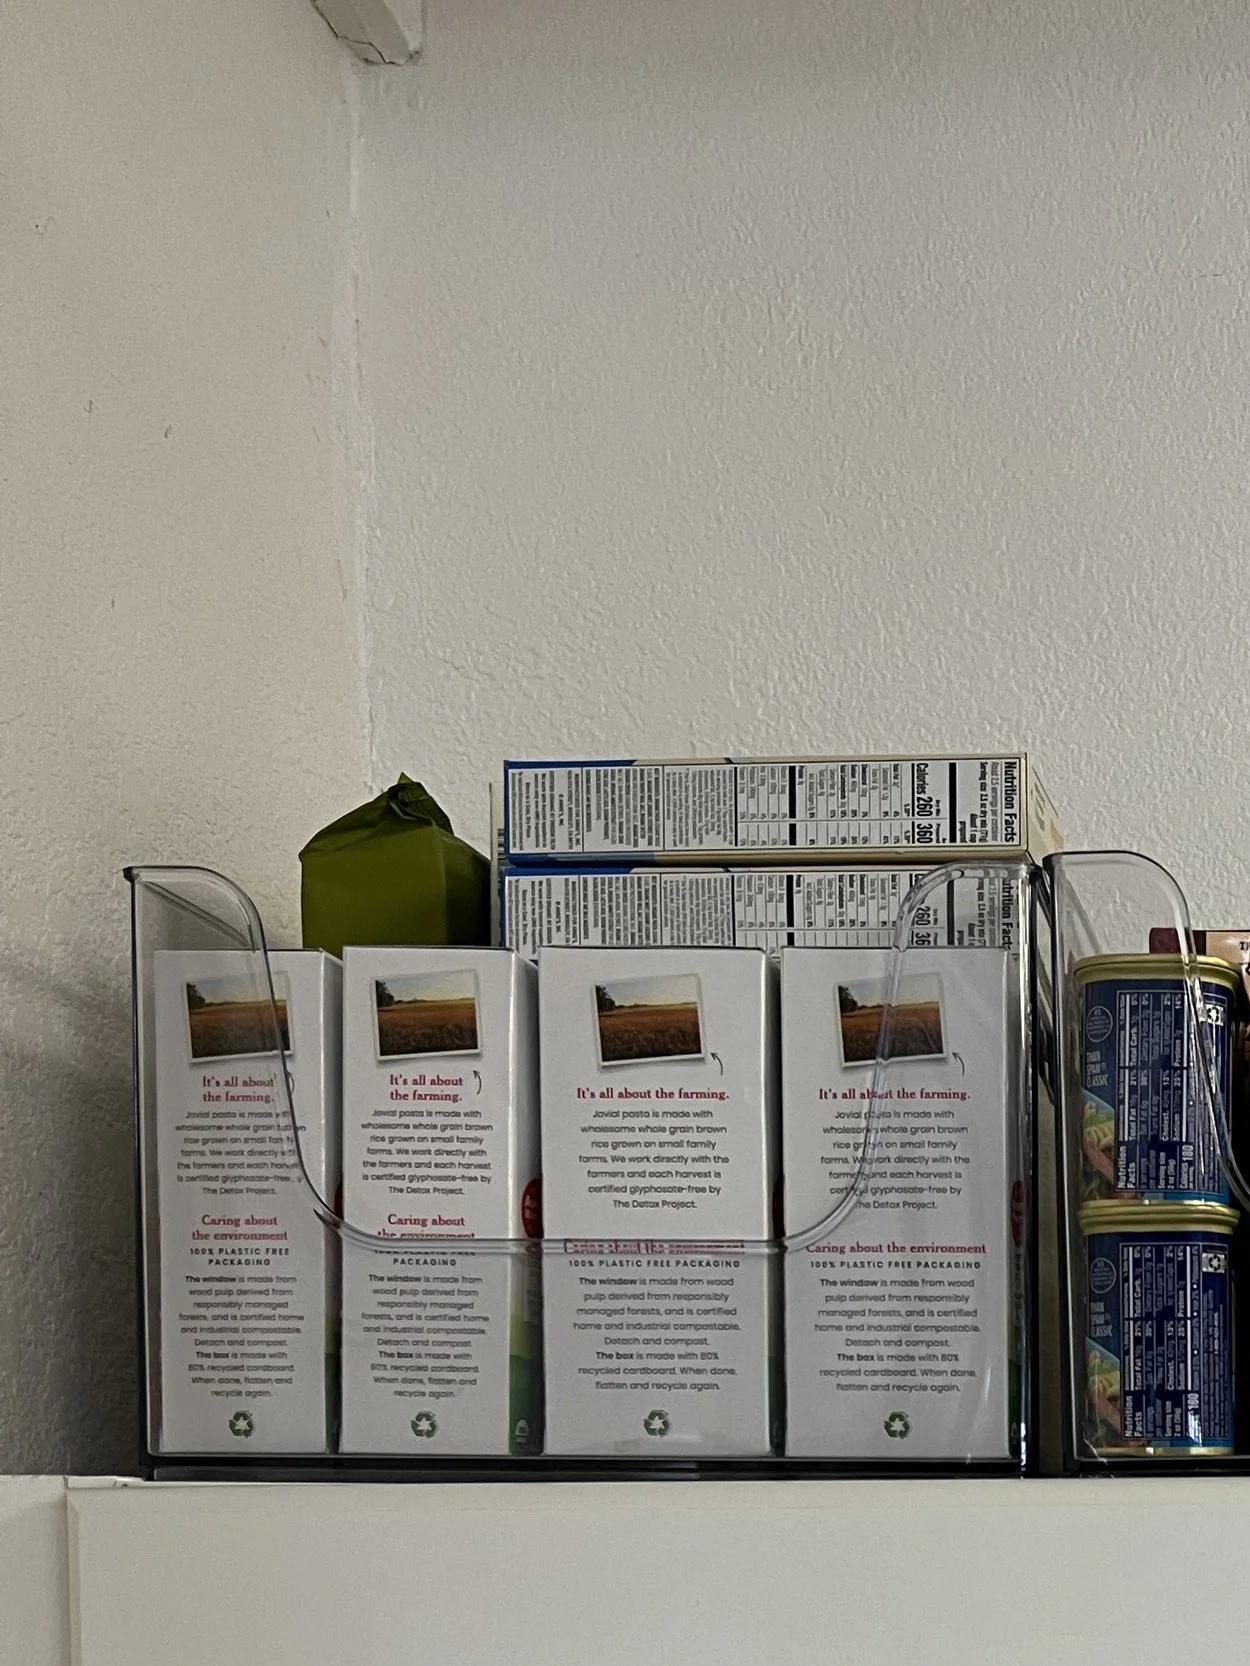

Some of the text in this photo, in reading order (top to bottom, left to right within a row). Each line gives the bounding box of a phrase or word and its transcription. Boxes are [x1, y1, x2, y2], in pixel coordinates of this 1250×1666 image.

[916, 763, 933, 843] Calories 260 360
[1004, 761, 1017, 843] Nutrition Facts
[1002, 880, 1014, 919] utrition
[915, 906, 931, 926] 260
[203, 1076, 275, 1087] It's all about
[390, 1074, 463, 1086] It's all about
[203, 1091, 274, 1104] the farming.
[390, 1089, 462, 1103] the farming.
[577, 1087, 729, 1101] It's all about the farming.
[819, 1088, 838, 1100] It's
[841, 1088, 856, 1099] all
[897, 1087, 916, 1099] the
[920, 1088, 970, 1101] farming.
[593, 1109, 713, 1120] Jovial pasta is made with
[580, 1125, 727, 1135] wholesome whole grain brown
[591, 1140, 609, 1148] rice
[611, 1141, 642, 1151] grown
[658, 1140, 684, 1148] small
[686, 1140, 717, 1151] family
[1182, 1145, 1194, 1161] 180
[579, 1155, 730, 1165] farms. We work directly with the
[1118, 1145, 1126, 1189] Nutrition
[587, 1170, 722, 1179] farmers and each harvest is
[1127, 1162, 1135, 1189] Facts
[588, 1184, 721, 1196] certified glyphosate-free by
[613, 1199, 697, 1210] The Detox Project.
[201, 1214, 278, 1228] Caring about
[387, 1213, 465, 1228] Caring about
[192, 1229, 288, 1240] the environment
[190, 1248, 214, 1256] 100%
[265, 1248, 289, 1256] FREE
[806, 1241, 986, 1255] Caring about the environment
[208, 1258, 270, 1266] PACKAGING
[393, 1258, 456, 1266] PACKAGING
[676, 1260, 740, 1268] PACKAGING
[840, 1261, 883, 1269] PLASTIC
[888, 1261, 912, 1269] FREE
[916, 1261, 981, 1269] PACKAGING
[579, 1277, 597, 1285] The
[598, 1277, 638, 1285] window
[680, 1277, 704, 1285] from
[706, 1278, 734, 1286] wood
[1188, 1393, 1199, 1409] 180
[1134, 1411, 1142, 1437] Facts
